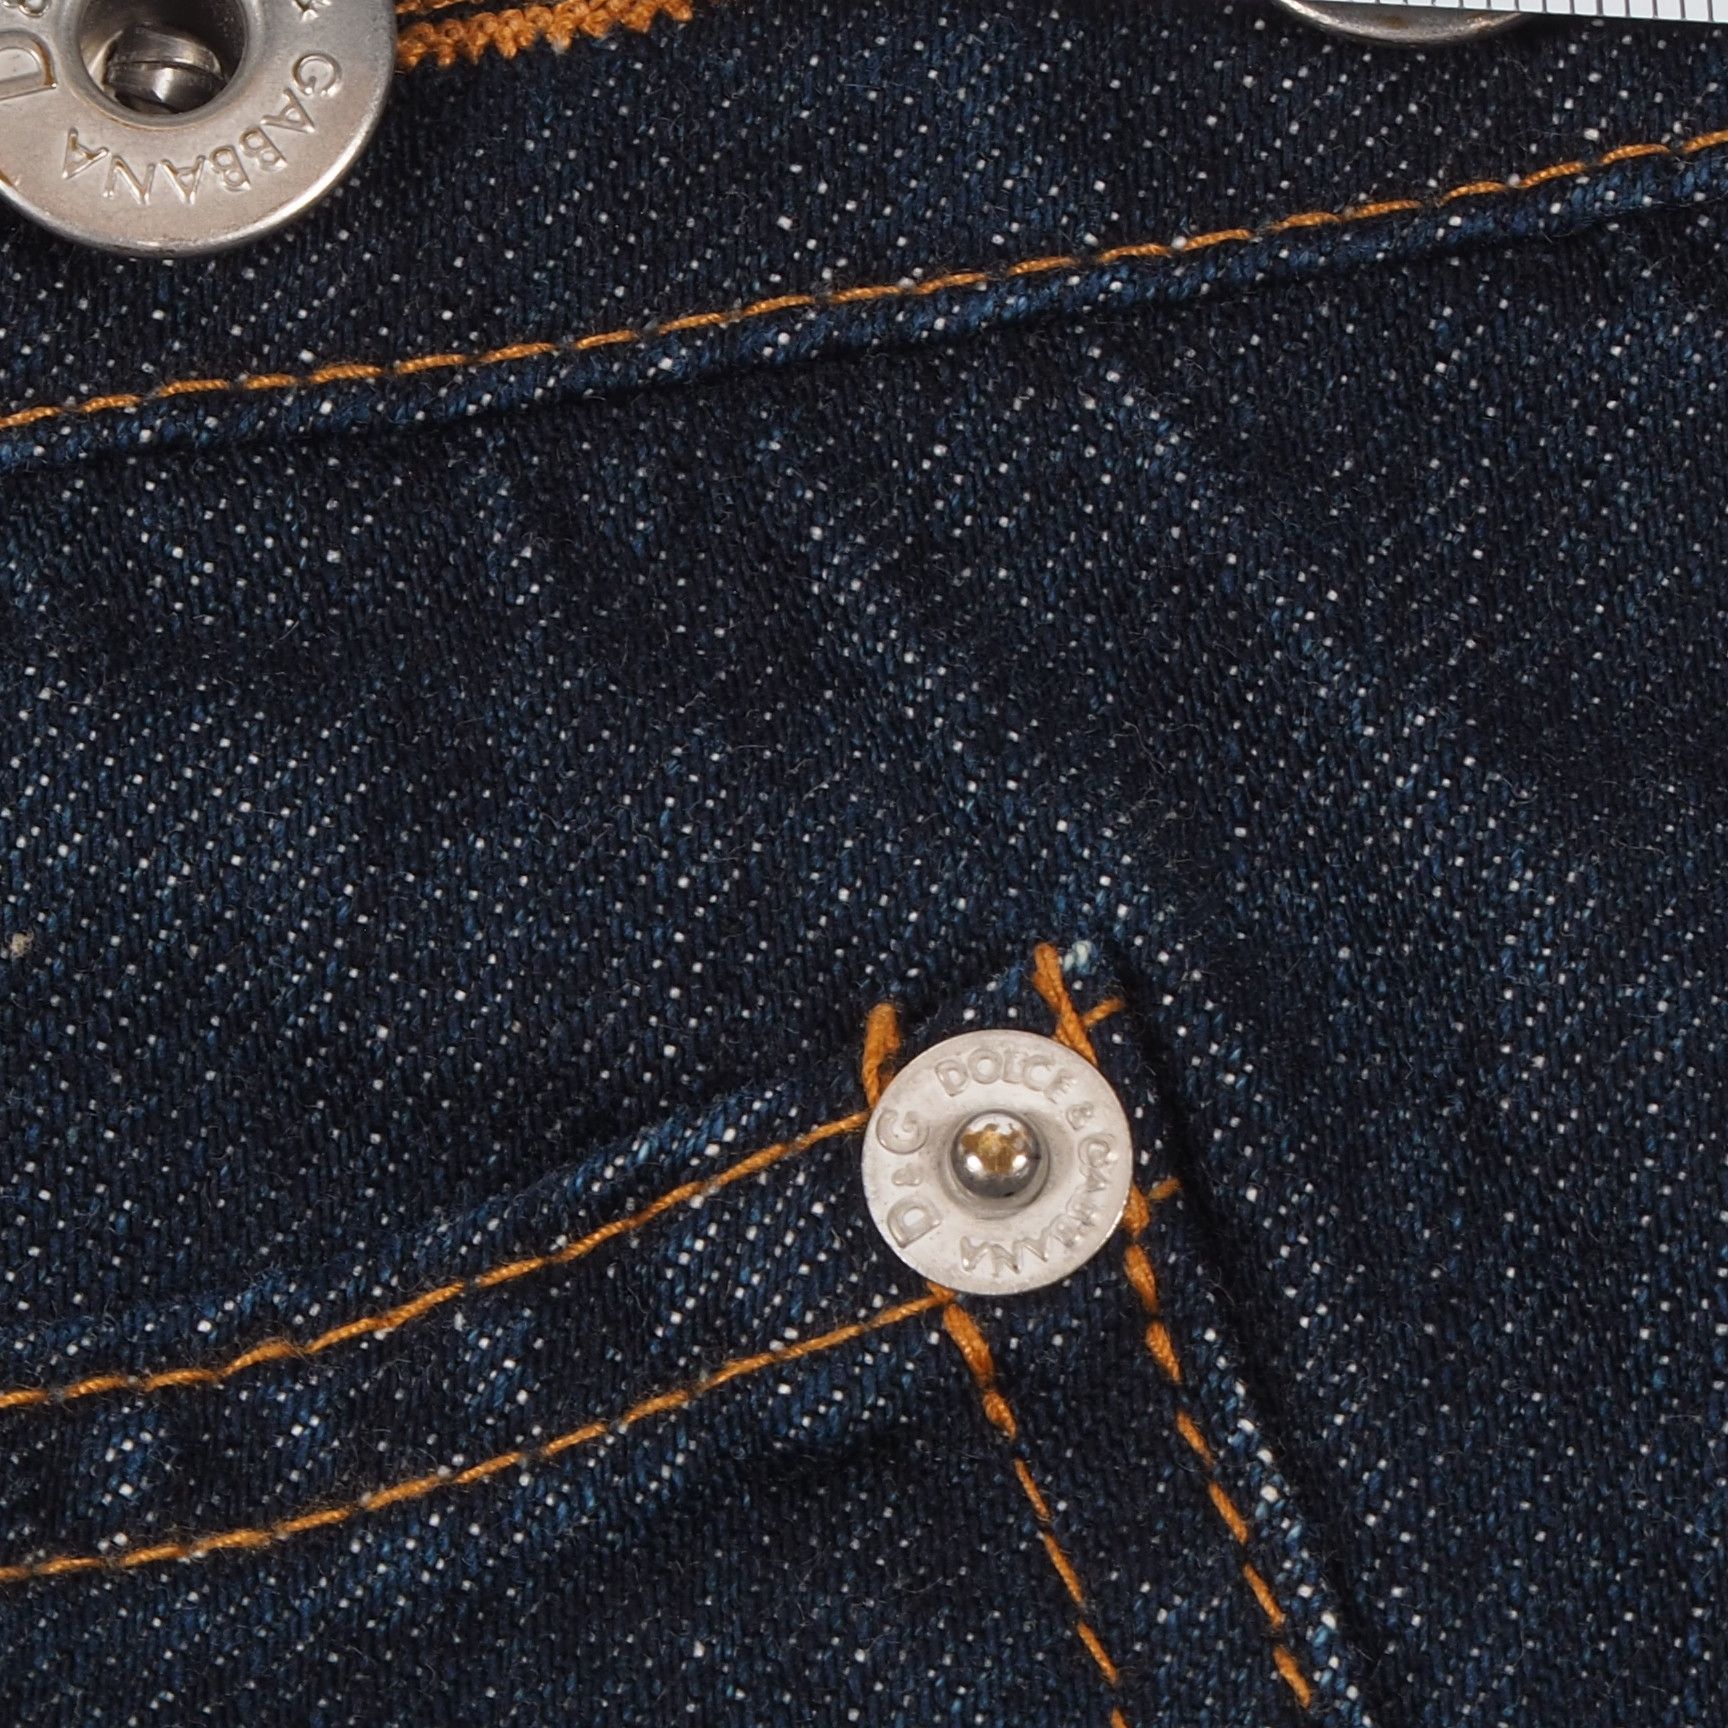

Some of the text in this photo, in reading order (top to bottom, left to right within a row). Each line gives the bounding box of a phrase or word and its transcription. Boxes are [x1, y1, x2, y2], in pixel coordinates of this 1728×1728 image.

[61, 51, 343, 206] GABBANA
[934, 1047, 1078, 1105] DOLCE
[874, 1106, 945, 1249] D&G
